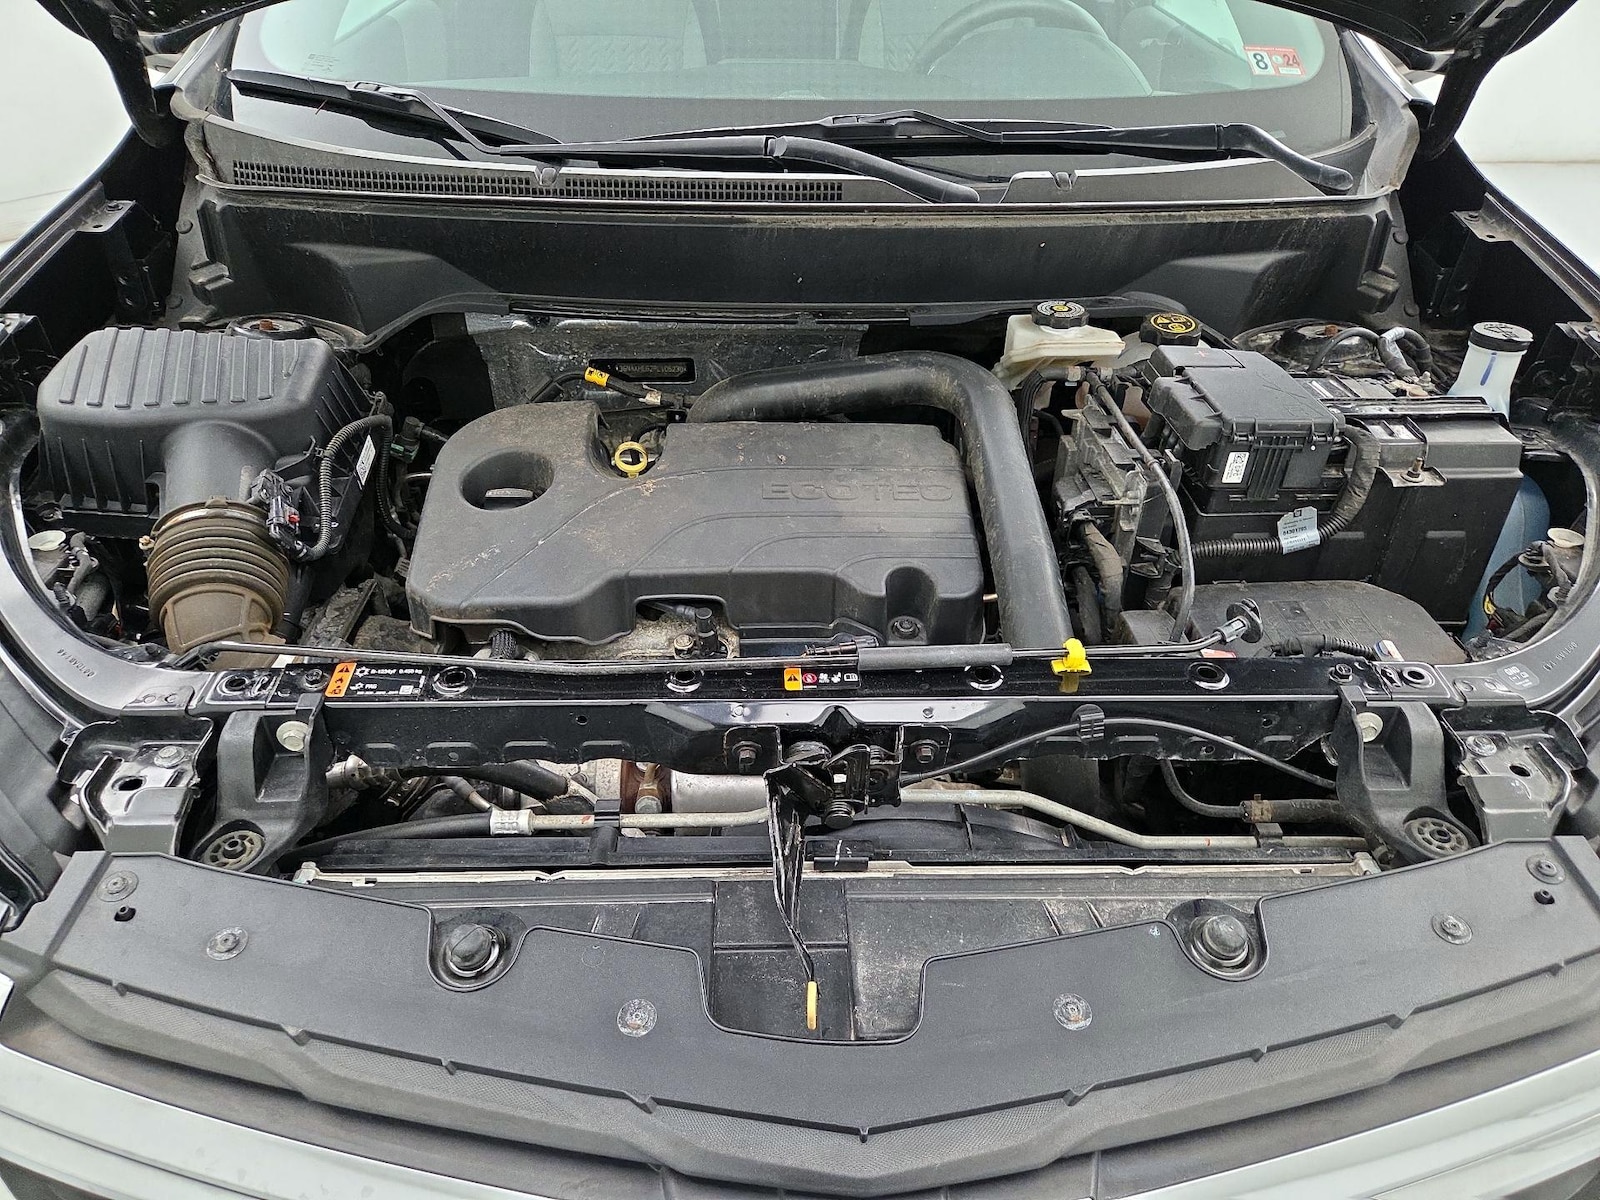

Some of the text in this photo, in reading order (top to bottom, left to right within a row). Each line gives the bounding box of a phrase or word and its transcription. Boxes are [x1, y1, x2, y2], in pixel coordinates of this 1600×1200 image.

[1253, 52, 1300, 70] 8 24
[761, 481, 953, 501] ECOTEC
